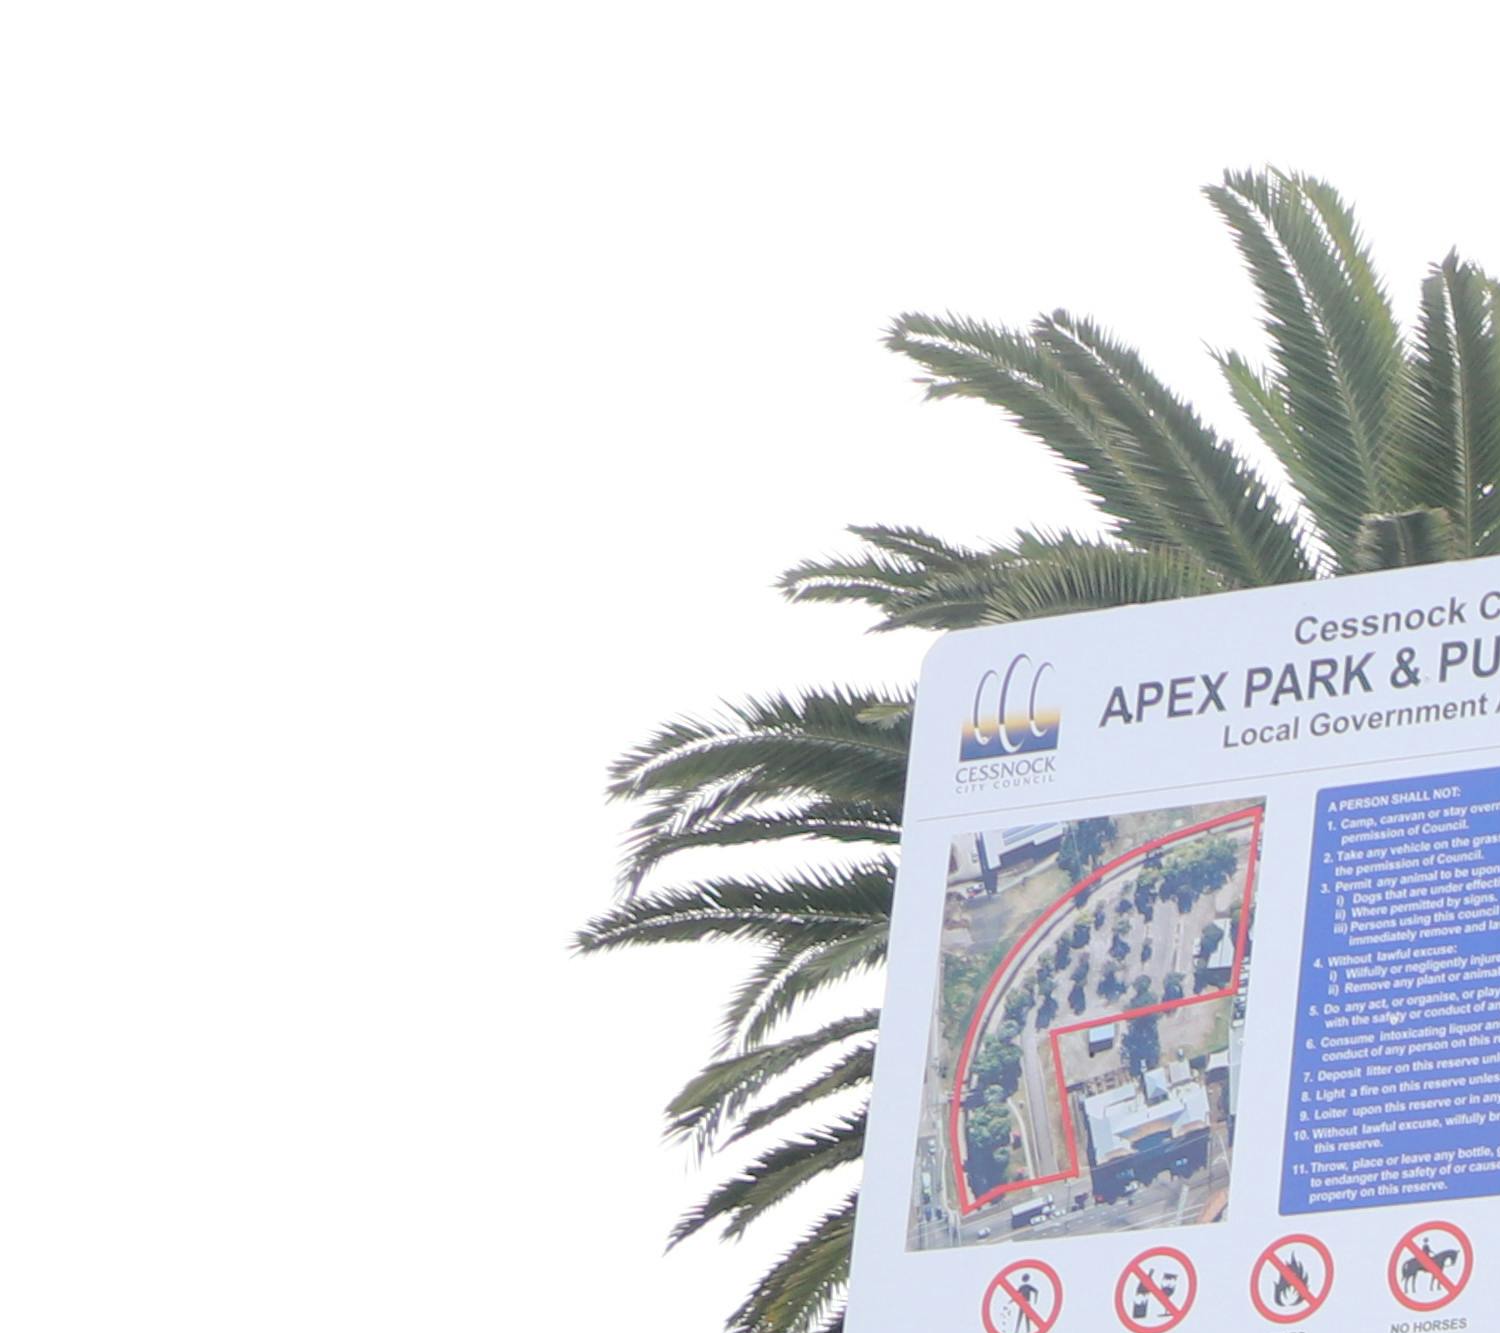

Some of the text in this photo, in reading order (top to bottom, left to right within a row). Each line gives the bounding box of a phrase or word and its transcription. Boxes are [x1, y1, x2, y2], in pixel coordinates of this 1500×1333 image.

[1294, 596, 1466, 645] Cessnock
[1098, 671, 1228, 728] APEX
[1243, 651, 1374, 708] PARK
[1389, 646, 1421, 689] &
[1222, 715, 1299, 748] Local
[1309, 693, 1488, 737] Government
[954, 755, 1056, 784] CESSNOCK
[954, 773, 1054, 794] CITY COUNCIL
[1327, 800, 1338, 813] A
[1338, 794, 1390, 811] PERSON
[1389, 790, 1431, 805] SHALL
[1327, 820, 1336, 831] 1.
[1378, 811, 1426, 825] caravan
[1426, 808, 1441, 819] or
[1442, 805, 1468, 818] stay
[1340, 827, 1406, 847] permission
[1405, 822, 1421, 836] of
[1322, 851, 1333, 864] 2.
[1336, 849, 1364, 861] Take
[1365, 847, 1388, 859] any
[1389, 840, 1431, 855] vehicle
[1432, 840, 1449, 850] on
[1450, 836, 1470, 848] the
[1334, 864, 1354, 877] the
[1354, 857, 1420, 877] permission
[1421, 853, 1436, 867] of
[1320, 882, 1331, 894] 3.
[1334, 877, 1372, 893] Permit
[1375, 876, 1398, 888] any
[1399, 869, 1439, 885] animal
[1438, 869, 1453, 880] to
[1453, 866, 1469, 878] be
[1312, 957, 1324, 969] 4.
[1327, 952, 1373, 967] Without
[1375, 946, 1412, 962] lawful
[1328, 970, 1338, 983] i)
[1345, 964, 1388, 979] Wilfully
[1389, 964, 1403, 975] or
[1404, 955, 1468, 974] negligently
[1303, 1071, 1313, 1083] 7.
[1316, 1066, 1362, 1083] Deposit
[1365, 1064, 1393, 1076] litter
[1393, 1063, 1410, 1074] on
[1411, 1059, 1434, 1072] this
[1435, 1056, 1480, 1069] reserve
[1313, 1140, 1336, 1154] this
[1292, 1163, 1308, 1175] 11.
[1352, 1157, 1384, 1172] place
[1385, 1155, 1400, 1166] or
[1400, 1152, 1432, 1164] leave
[1432, 1150, 1456, 1163] any
[1412, 1317, 1467, 1333] HORSES
